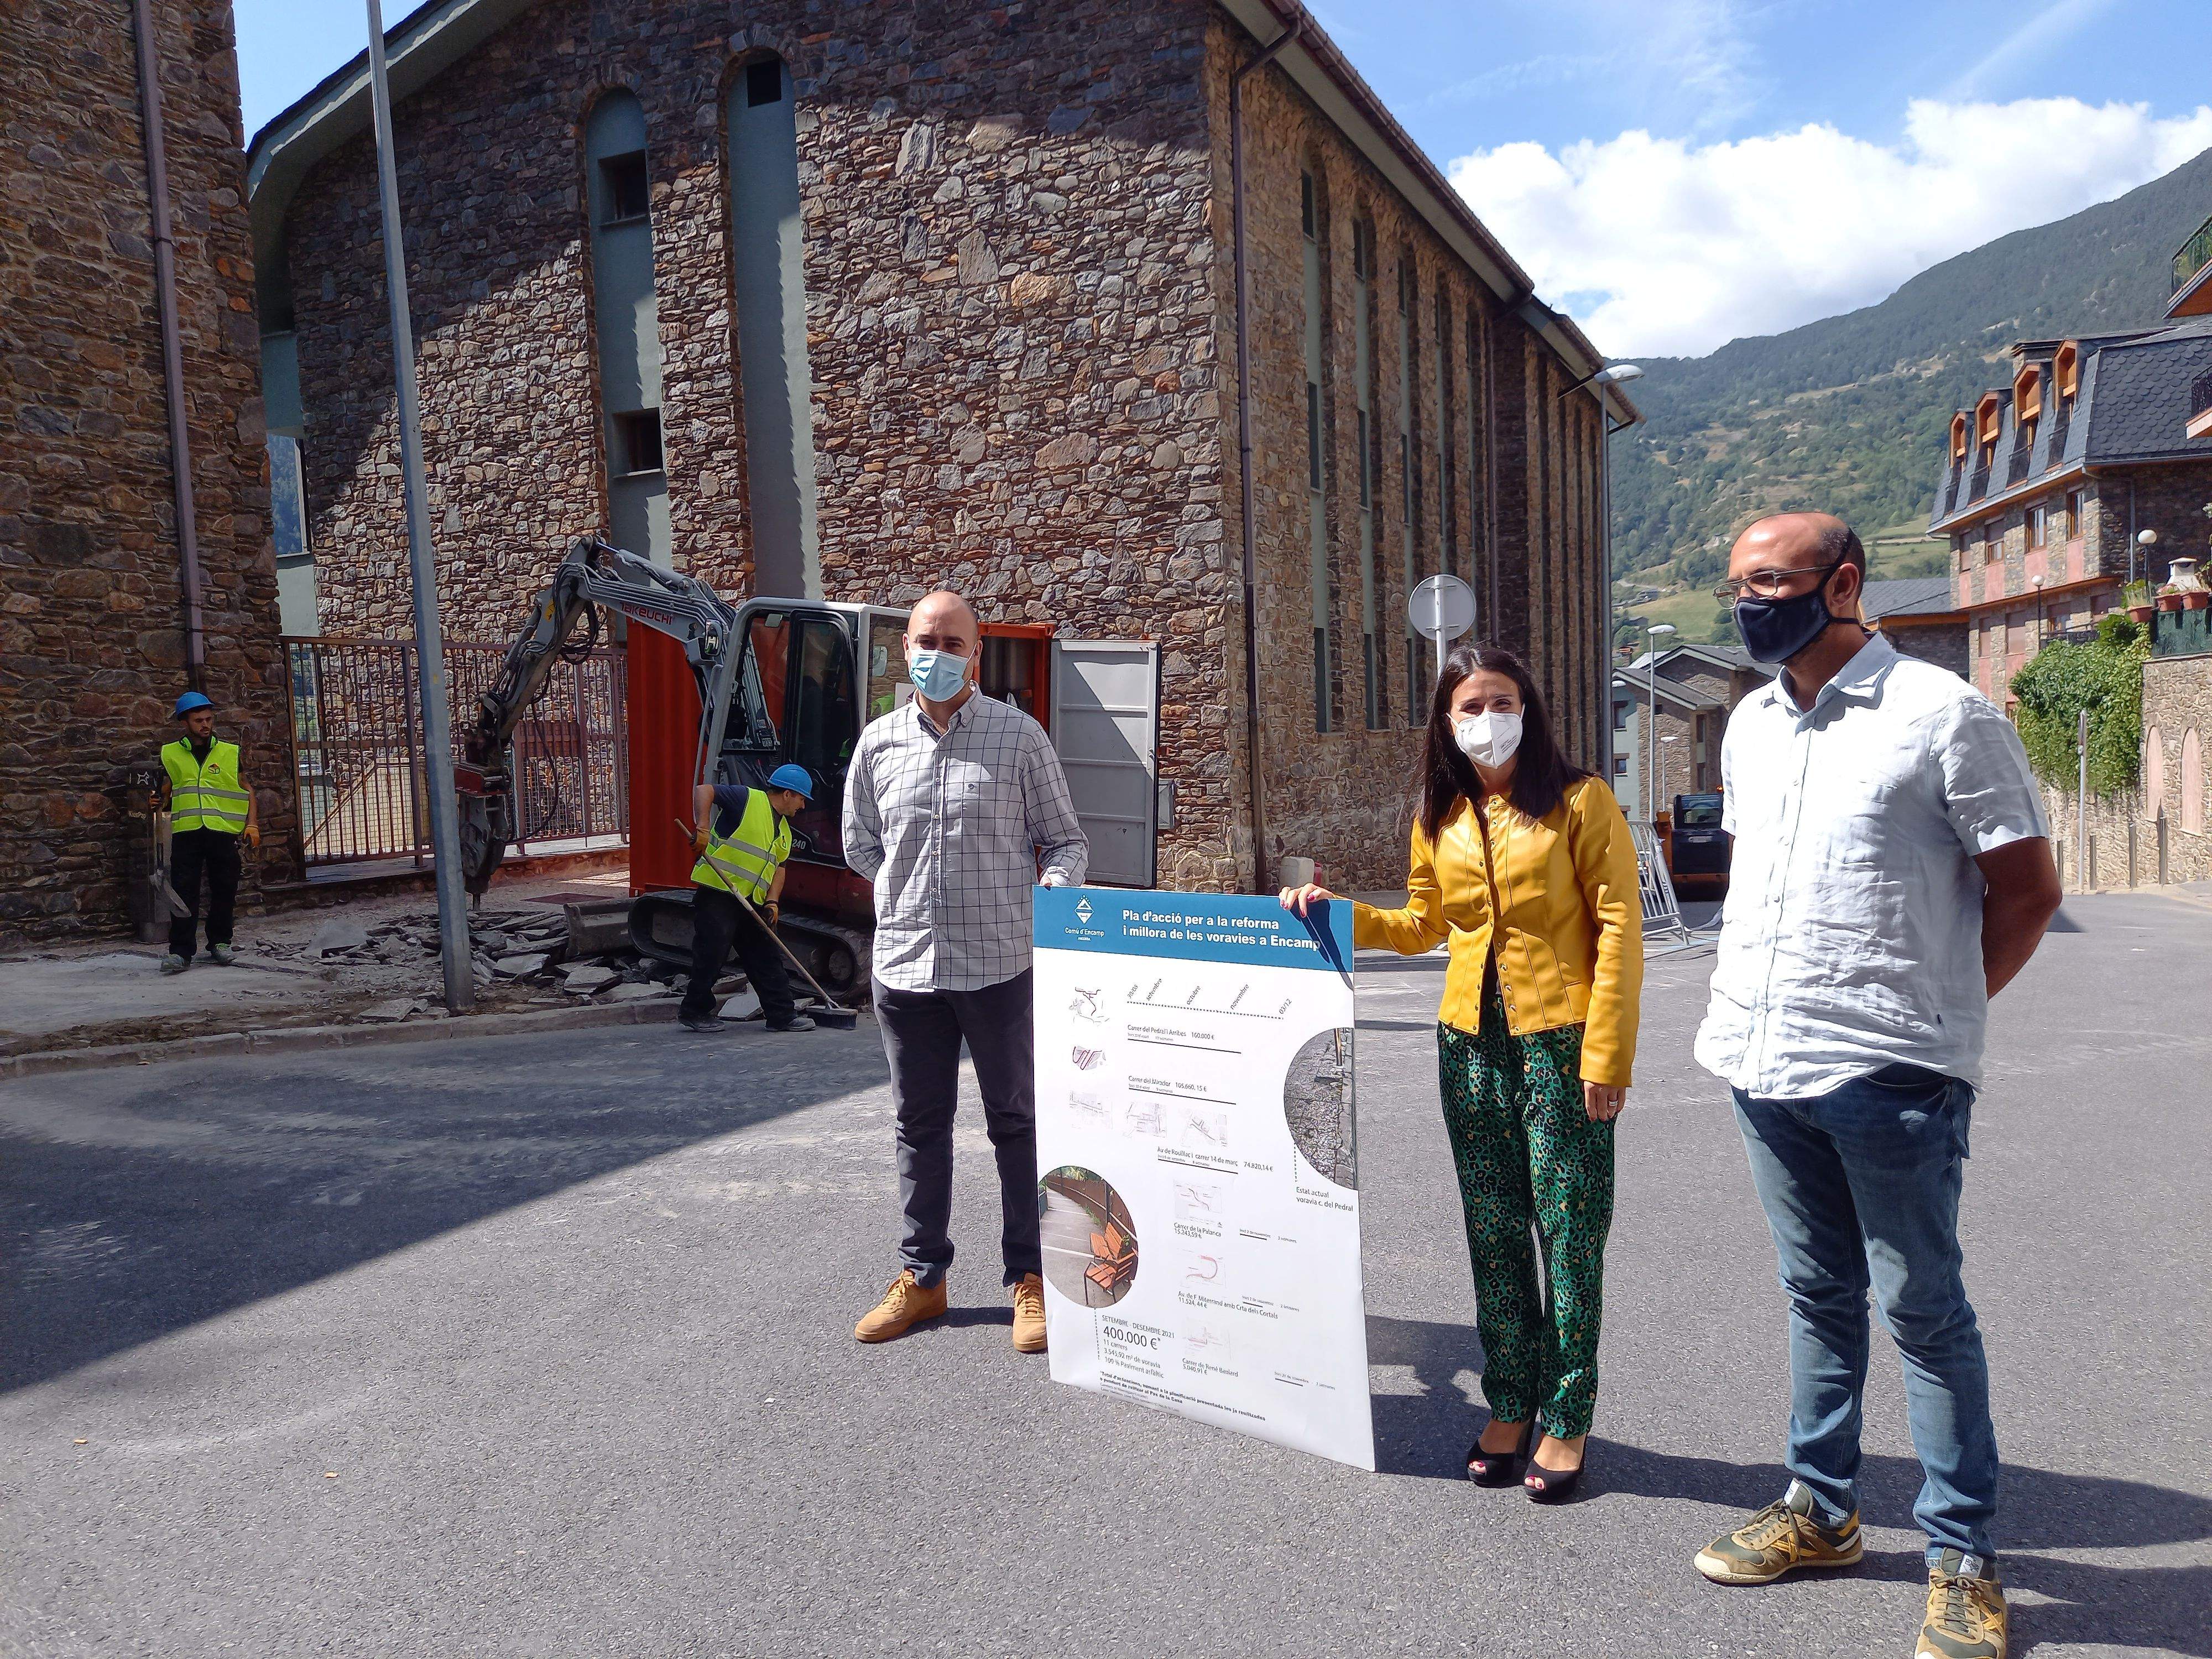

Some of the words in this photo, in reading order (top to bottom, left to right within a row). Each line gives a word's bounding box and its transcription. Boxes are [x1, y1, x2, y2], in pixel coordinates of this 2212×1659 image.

[1123, 909, 1140, 921] Pla
[1142, 911, 1182, 924] d'acció
[1185, 916, 1203, 926] per
[1206, 917, 1214, 926] a
[1217, 915, 1228, 927] la
[1231, 916, 1279, 930] reforma
[1123, 925, 1126, 936] i
[1129, 926, 1167, 938] millora
[1170, 928, 1183, 940] de
[1186, 929, 1203, 941] les
[1206, 933, 1255, 945] voravies
[1259, 937, 1267, 946] a
[1270, 935, 1320, 952] Encamp
[1146, 978, 1162, 1001] setembre
[1187, 985, 1201, 1005] octubre
[1230, 984, 1249, 1010] novembre
[1279, 998, 1292, 1014] 03/12
[1296, 1186, 1310, 1195] Estat
[1334, 1202, 1353, 1212] Pedral
[1260, 1310, 1278, 1319] Cortals
[1102, 1315, 1129, 1327] SETEMBRE
[1133, 1323, 1161, 1335] DESEMBRE
[1162, 1330, 1175, 1338] 2021
[1104, 1326, 1147, 1347] 400.000
[1111, 1342, 1128, 1350] carrers
[1121, 1361, 1144, 1373] Paviment
[1142, 1359, 1161, 1369] voravia
[1182, 1358, 1197, 1367] Carrer
[1197, 1399, 1223, 1410] presentada
